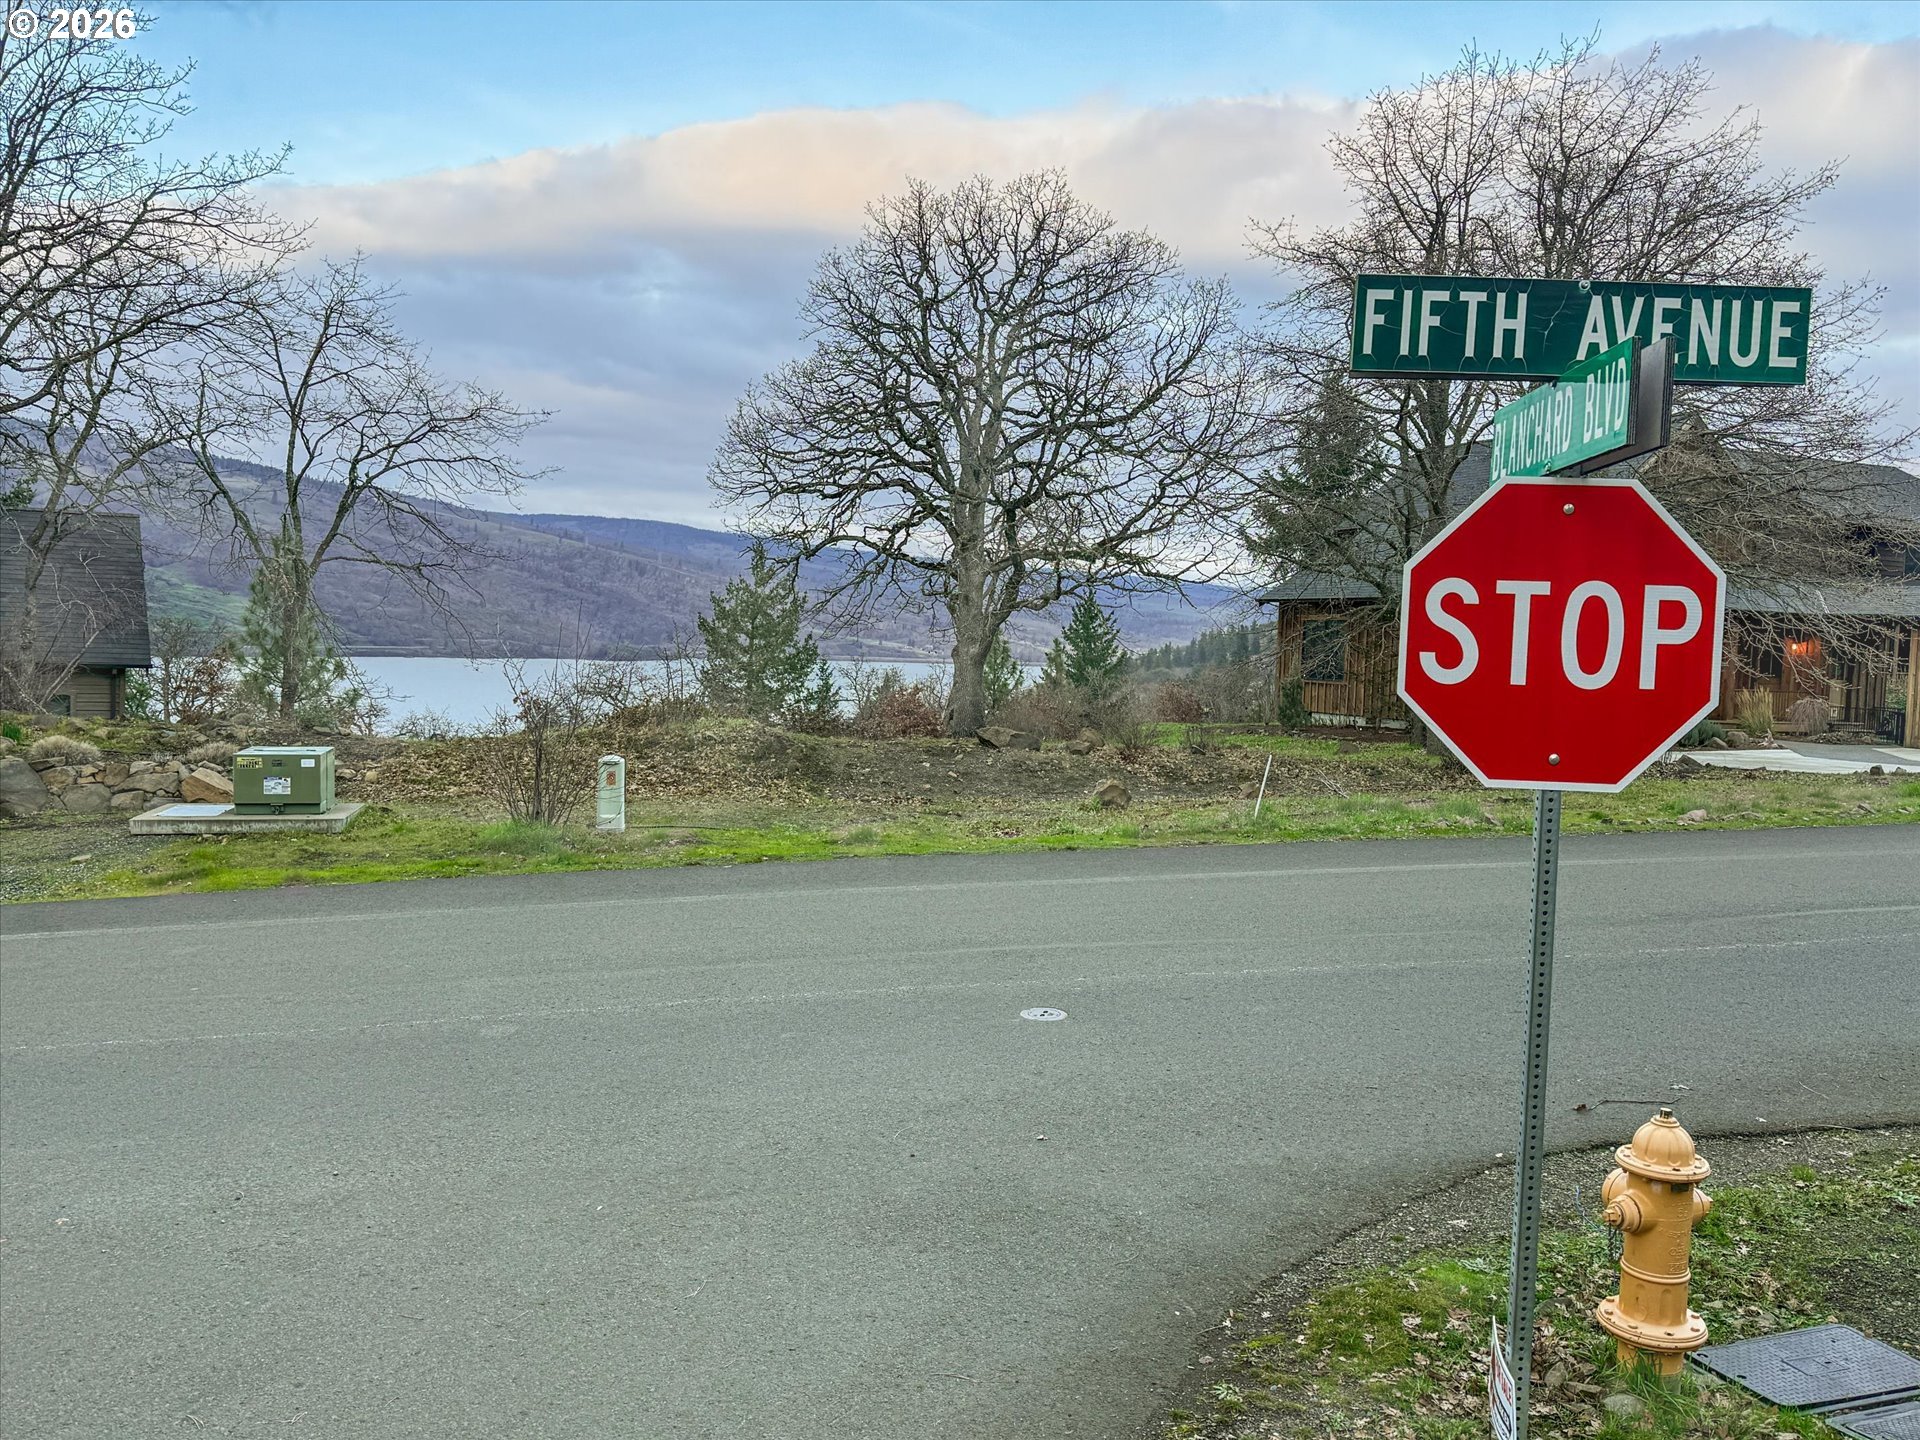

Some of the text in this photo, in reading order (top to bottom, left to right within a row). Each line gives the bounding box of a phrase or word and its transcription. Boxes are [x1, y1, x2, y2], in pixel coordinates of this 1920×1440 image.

[1362, 288, 1801, 368] FIFTH AVENUE
[1492, 357, 1627, 481] BLANCHARD BLVD
[1418, 577, 1703, 690] STOP
